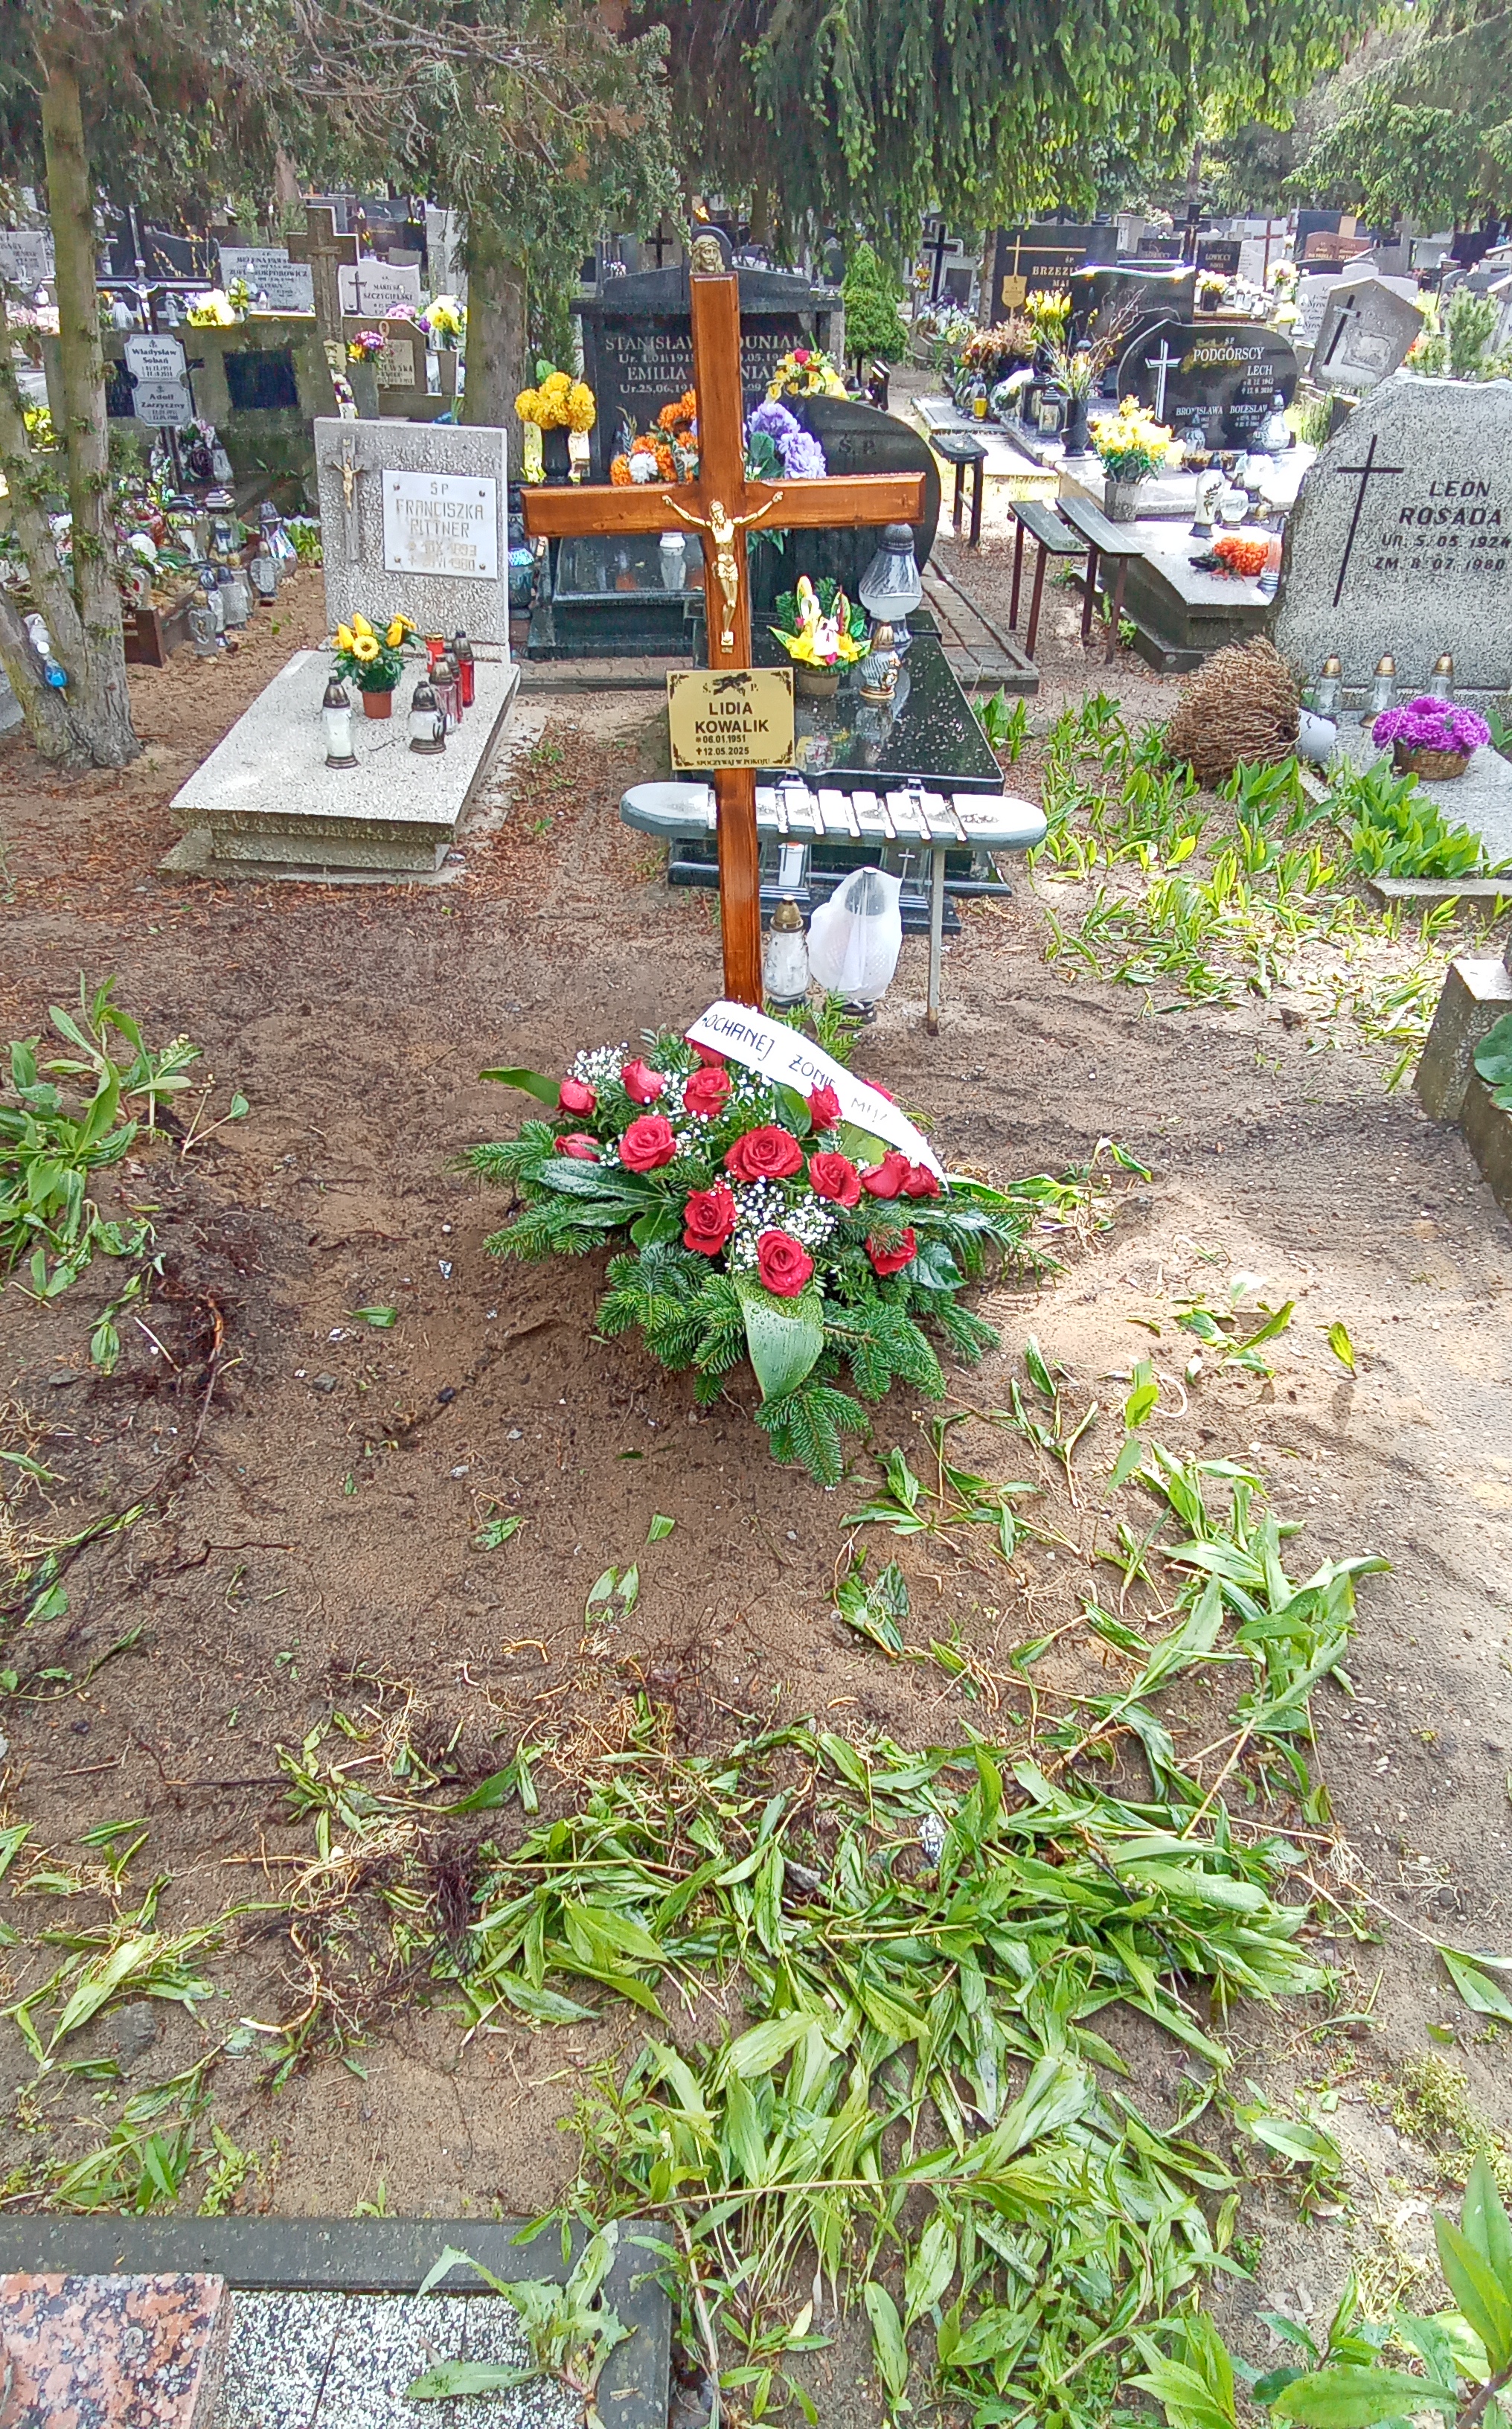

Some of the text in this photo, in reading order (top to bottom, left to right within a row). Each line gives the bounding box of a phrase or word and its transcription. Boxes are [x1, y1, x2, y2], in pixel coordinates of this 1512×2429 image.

[1193, 346, 1265, 362] PODGÓRSCY
[628, 367, 687, 380] EMILIA
[1246, 365, 1273, 376] LECH
[1429, 481, 1491, 497] LEON
[396, 499, 484, 520] FRANCISZKA
[1399, 507, 1502, 525] ROSADA
[411, 519, 470, 538] RITTNER
[709, 702, 752, 715] LIDIA
[695, 720, 769, 734] KOWALIK
